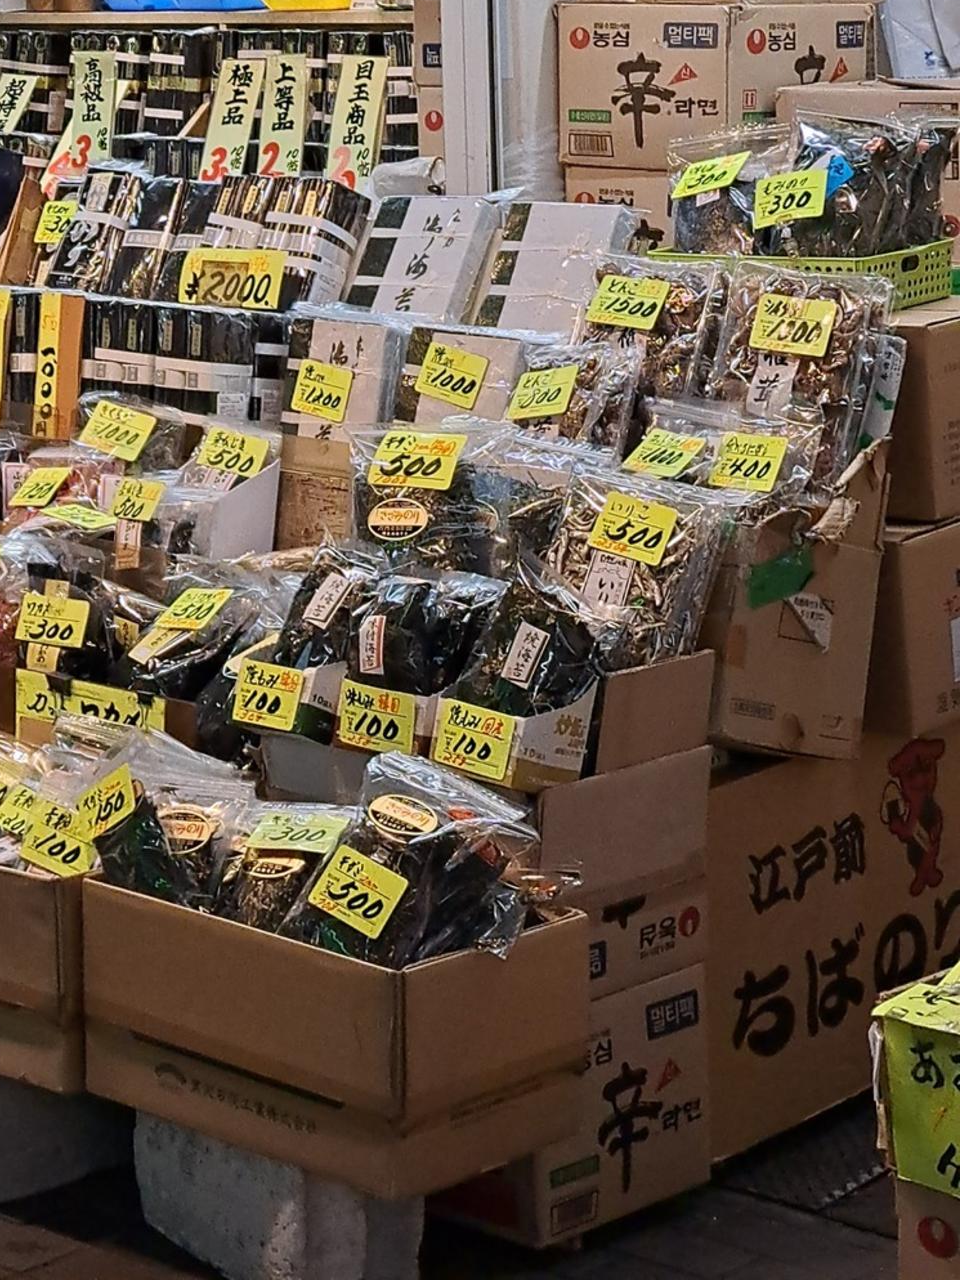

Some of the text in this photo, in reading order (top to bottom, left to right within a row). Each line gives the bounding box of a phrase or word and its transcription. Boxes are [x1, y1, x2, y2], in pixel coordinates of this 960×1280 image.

[592, 25, 714, 48] 농심 멀티팩
[767, 31, 797, 53] 농심
[80, 57, 105, 123] 高級品
[221, 63, 254, 126] 極上品
[271, 61, 296, 132] 上等品
[342, 59, 376, 146] 目玉商品
[674, 98, 720, 120] 라면
[688, 170, 728, 189] 300
[768, 191, 812, 215] 300
[207, 448, 255, 473] 500
[379, 452, 442, 477] 500
[729, 457, 773, 480] 400
[114, 496, 146, 519] 500
[604, 521, 664, 550] 500
[172, 602, 216, 621] 500
[29, 619, 74, 642] 300
[244, 689, 282, 713] 100
[354, 712, 400, 741] 100
[454, 733, 492, 761] 100
[268, 825, 327, 843] 300
[35, 832, 82, 865] 100
[749, 813, 867, 915] 江戸前
[326, 880, 385, 920] 500
